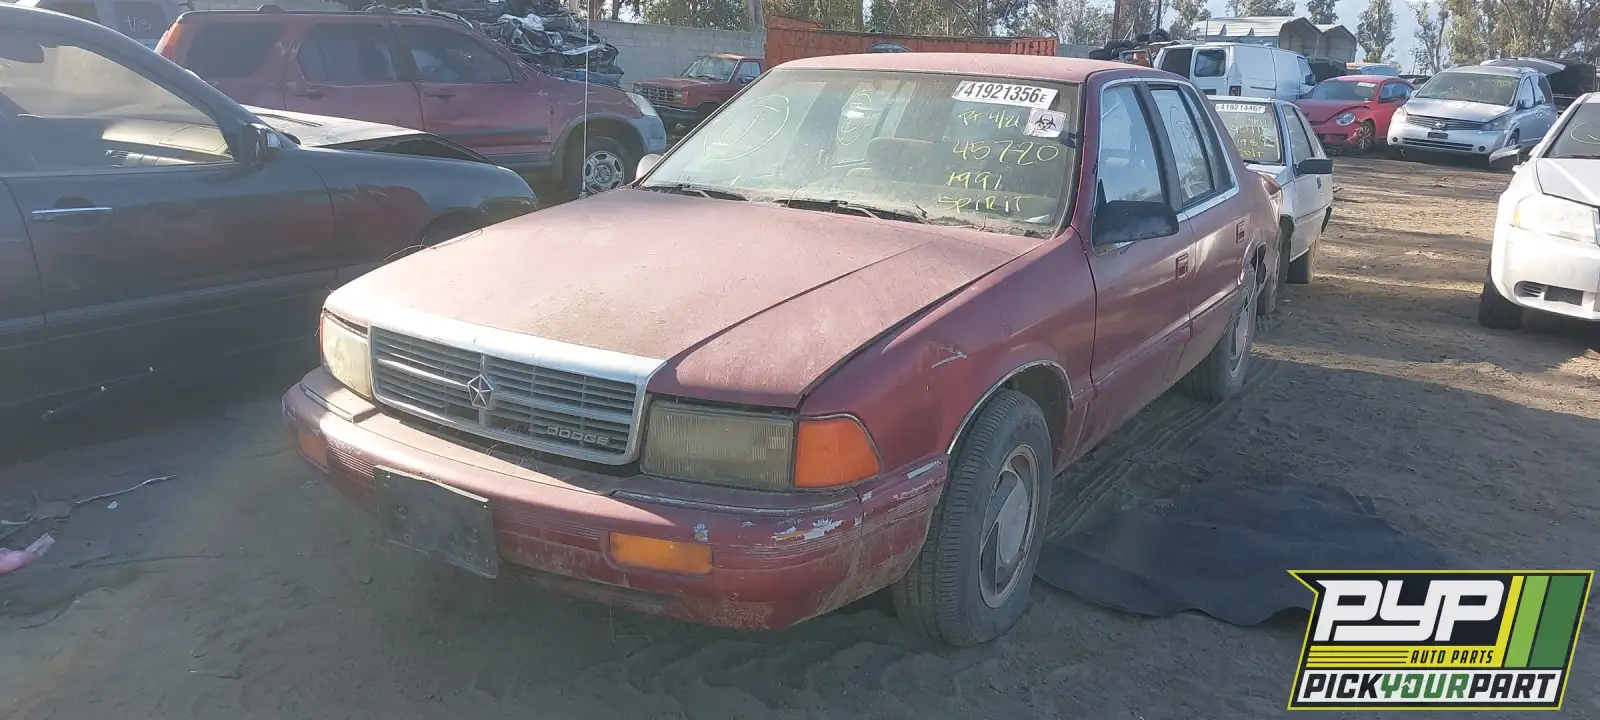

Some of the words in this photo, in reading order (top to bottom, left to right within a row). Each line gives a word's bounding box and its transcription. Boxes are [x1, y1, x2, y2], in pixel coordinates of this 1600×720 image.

[952, 140, 1059, 165] 45720
[944, 171, 1002, 190] 1991
[546, 424, 611, 446] DODGE
